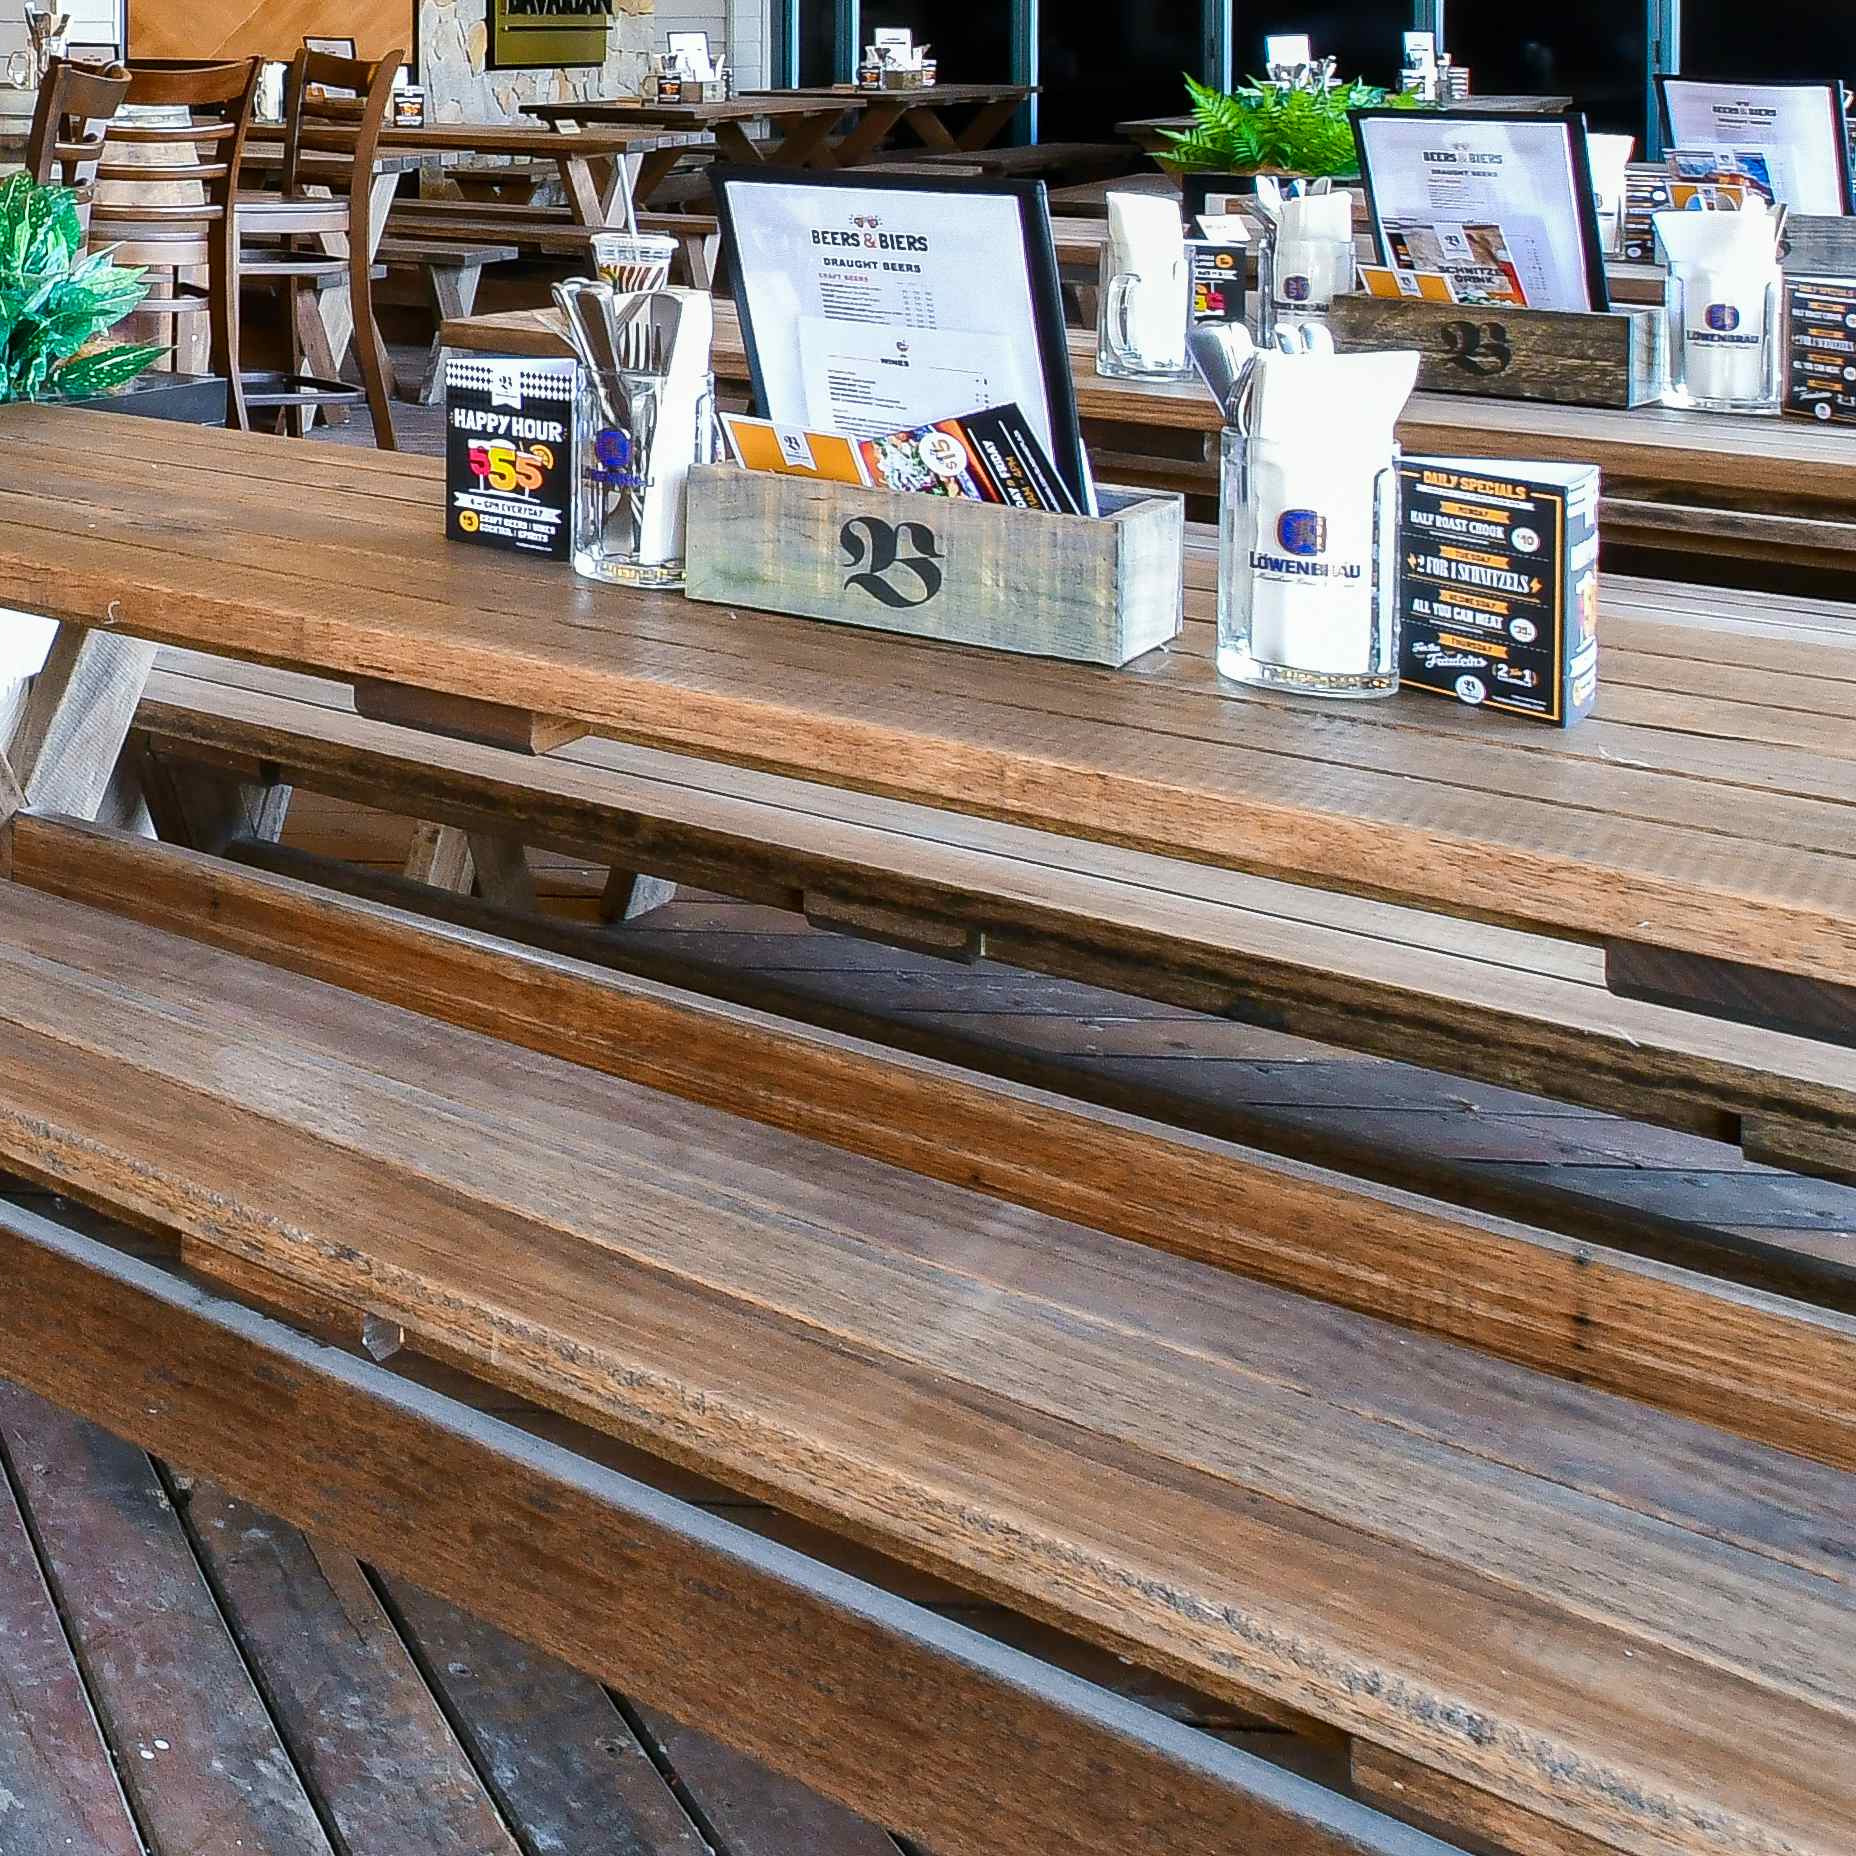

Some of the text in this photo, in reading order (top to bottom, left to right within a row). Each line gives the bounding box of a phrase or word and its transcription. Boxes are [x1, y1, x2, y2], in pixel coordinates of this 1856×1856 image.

[1423, 152, 1457, 162] BEERS
[1469, 153, 1503, 164] BIERS
[811, 230, 928, 252] BEERS & BIERS
[823, 257, 922, 274] DRAUGHT BEERS
[454, 408, 564, 443] HAPPY HOUR
[982, 440, 1011, 478] FRIDAY
[1423, 470, 1458, 488] DAILY
[1460, 476, 1527, 499] SPECIALS
[501, 503, 544, 517] EVERYDAY
[1410, 510, 1505, 539] HALF ROAST CHOOK
[1416, 554, 1529, 594] 2 FOR 1 SCHNITZELS
[1412, 598, 1431, 614] ALL
[1433, 602, 1452, 619] YOU
[1454, 607, 1474, 623] CAN
[1497, 663, 1532, 683] 2 1
